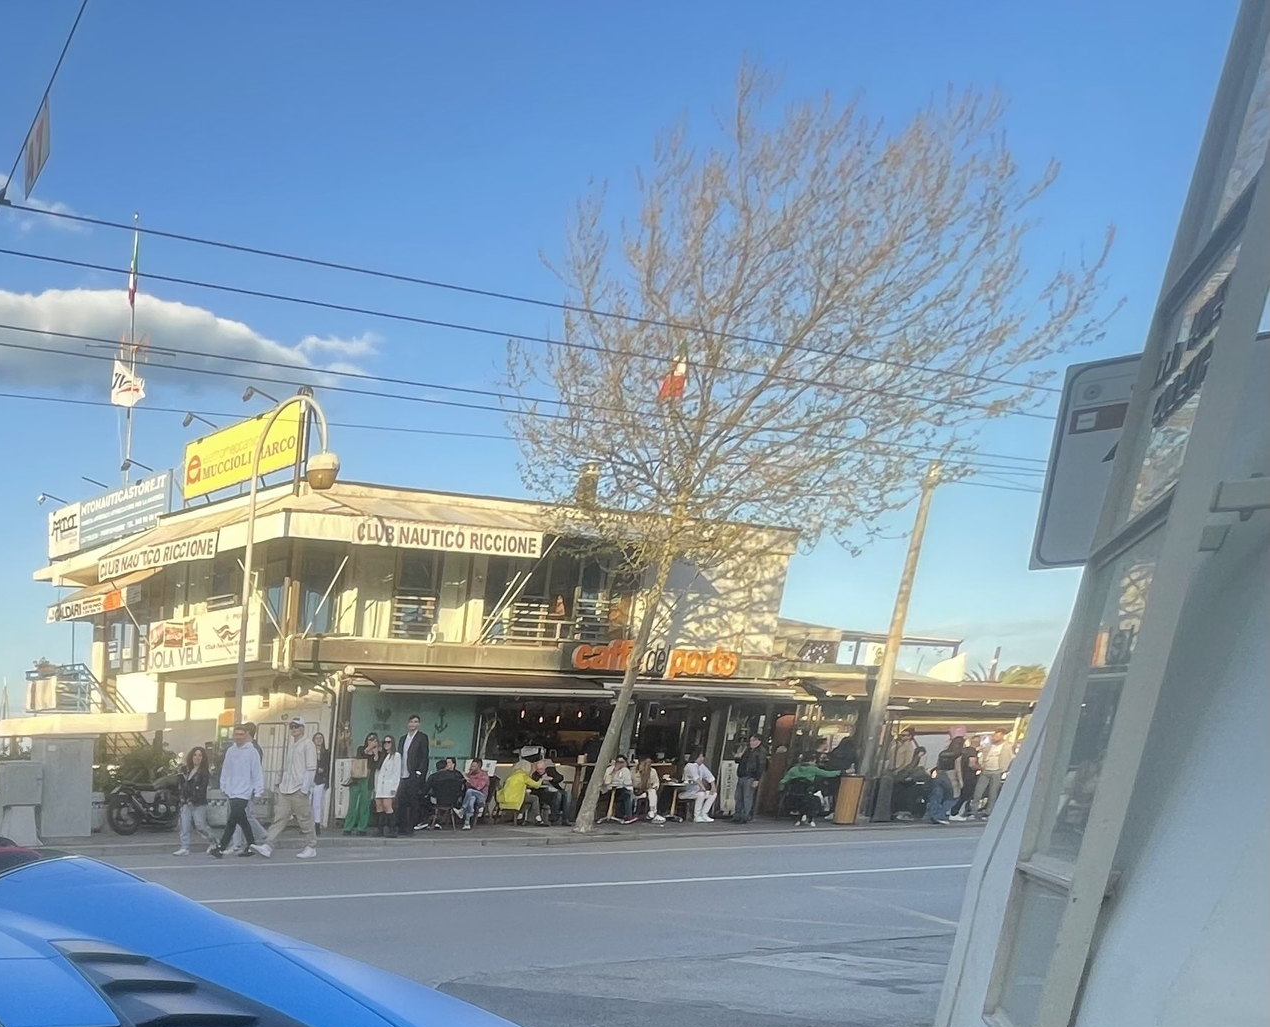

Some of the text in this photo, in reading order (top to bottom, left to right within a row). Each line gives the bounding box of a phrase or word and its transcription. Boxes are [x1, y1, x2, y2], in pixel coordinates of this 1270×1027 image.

[203, 451, 252, 480] MUCCIOLI
[358, 522, 537, 554] CLUB NAUTICO RICCIONE
[99, 557, 120, 579] CLUB
[163, 538, 214, 562] RICCIONE
[178, 644, 203, 666] VELA
[646, 645, 672, 672] del
[668, 646, 738, 679] porto
